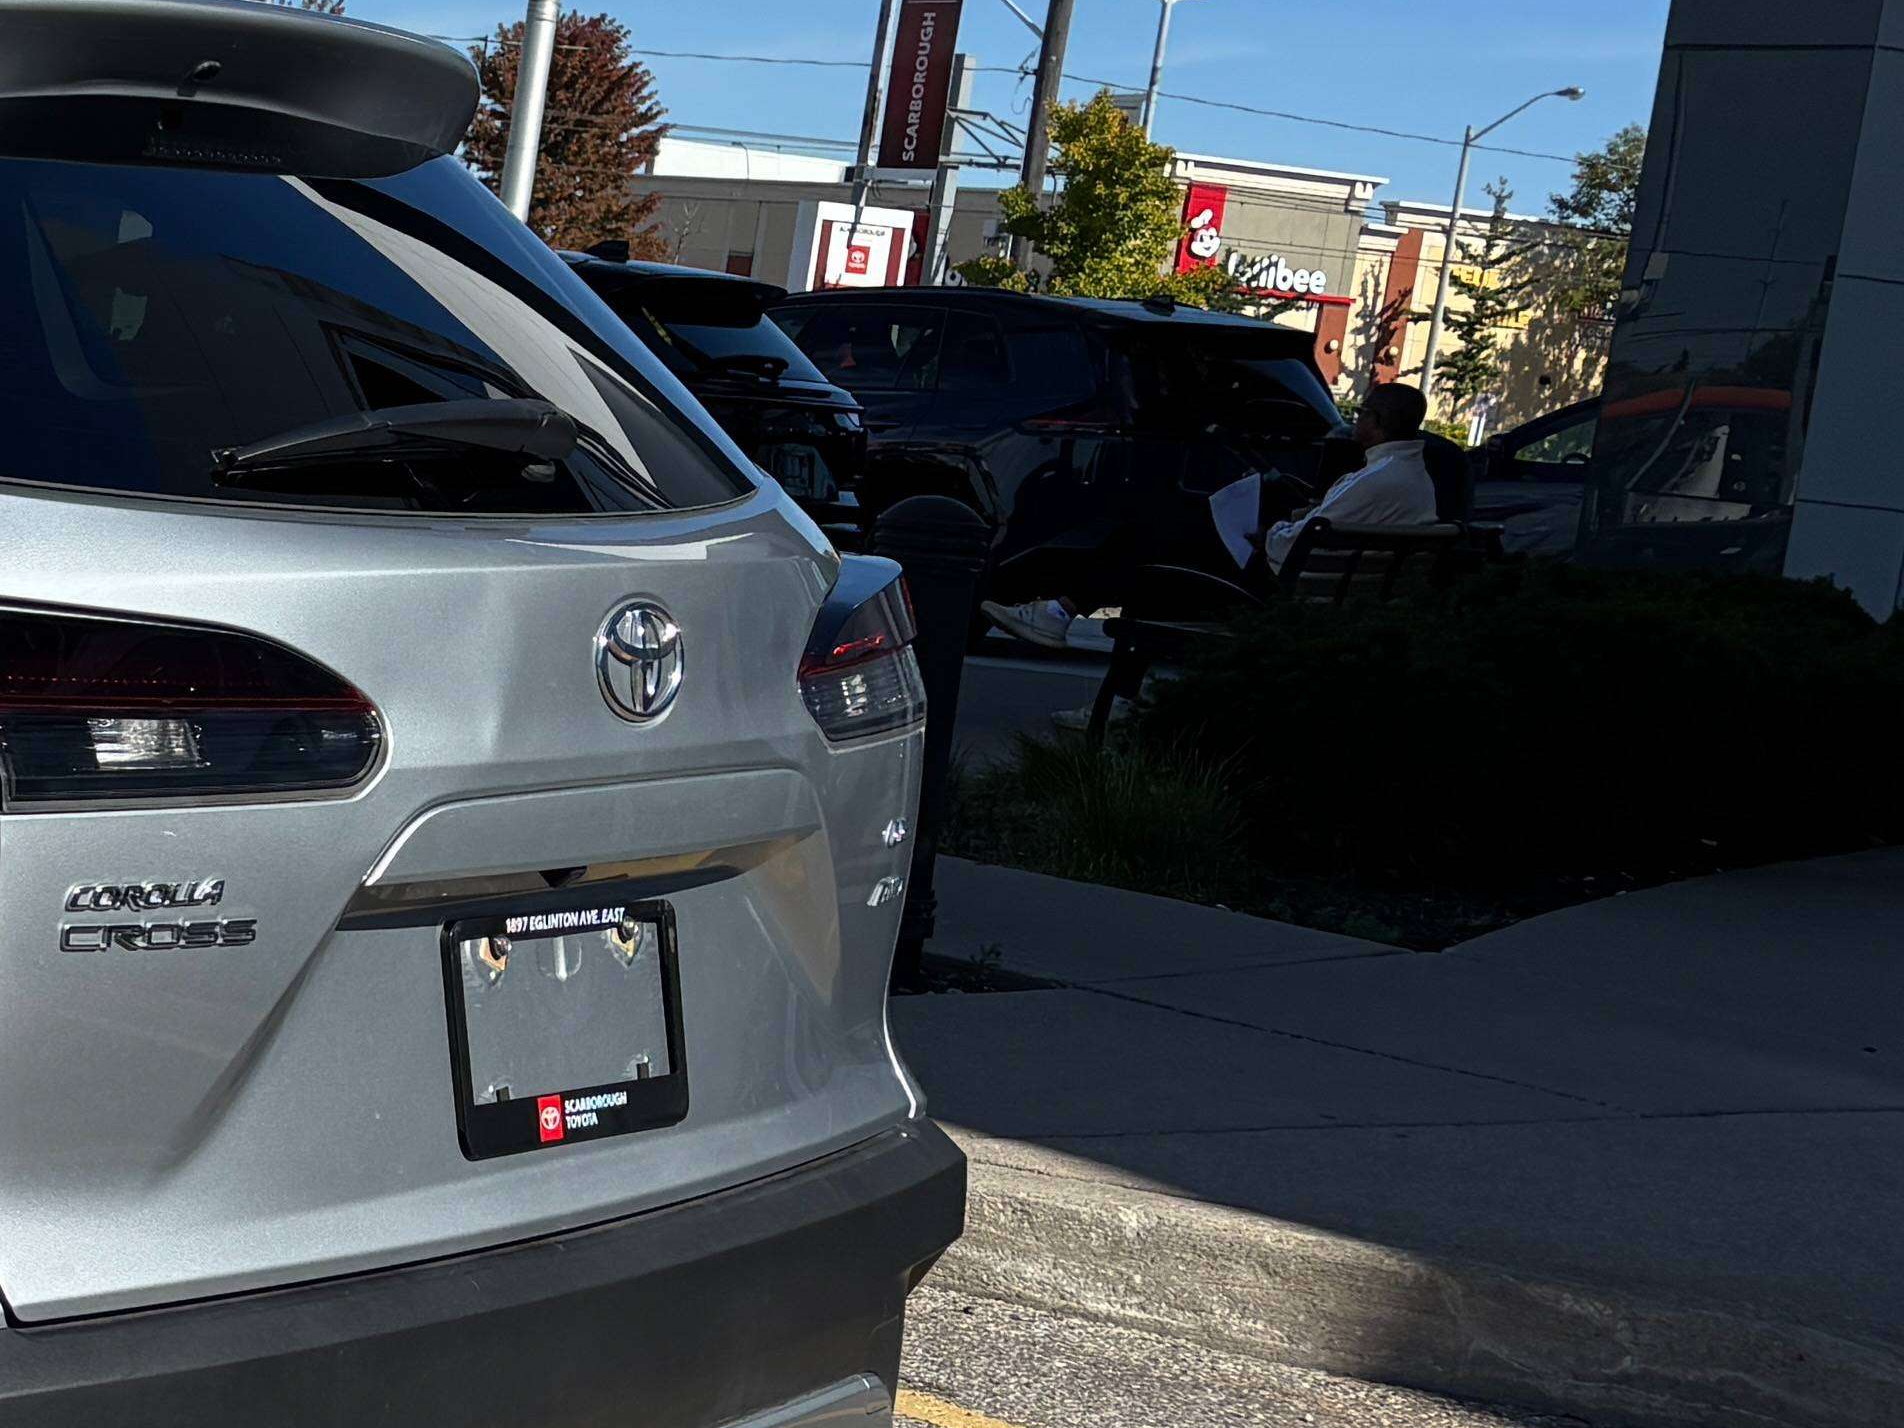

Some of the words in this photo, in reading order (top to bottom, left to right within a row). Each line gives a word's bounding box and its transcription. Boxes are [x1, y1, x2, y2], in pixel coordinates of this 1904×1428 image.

[902, 11, 937, 163] SCARBOROUGH
[64, 877, 226, 912] COROLLA
[506, 916, 528, 933] 1897
[530, 911, 579, 931] EGLINTON
[601, 907, 625, 924] EAST
[60, 918, 258, 953] CROSS
[564, 1091, 628, 1114] SCARBOROUGH
[565, 1112, 599, 1130] TOYOTA
